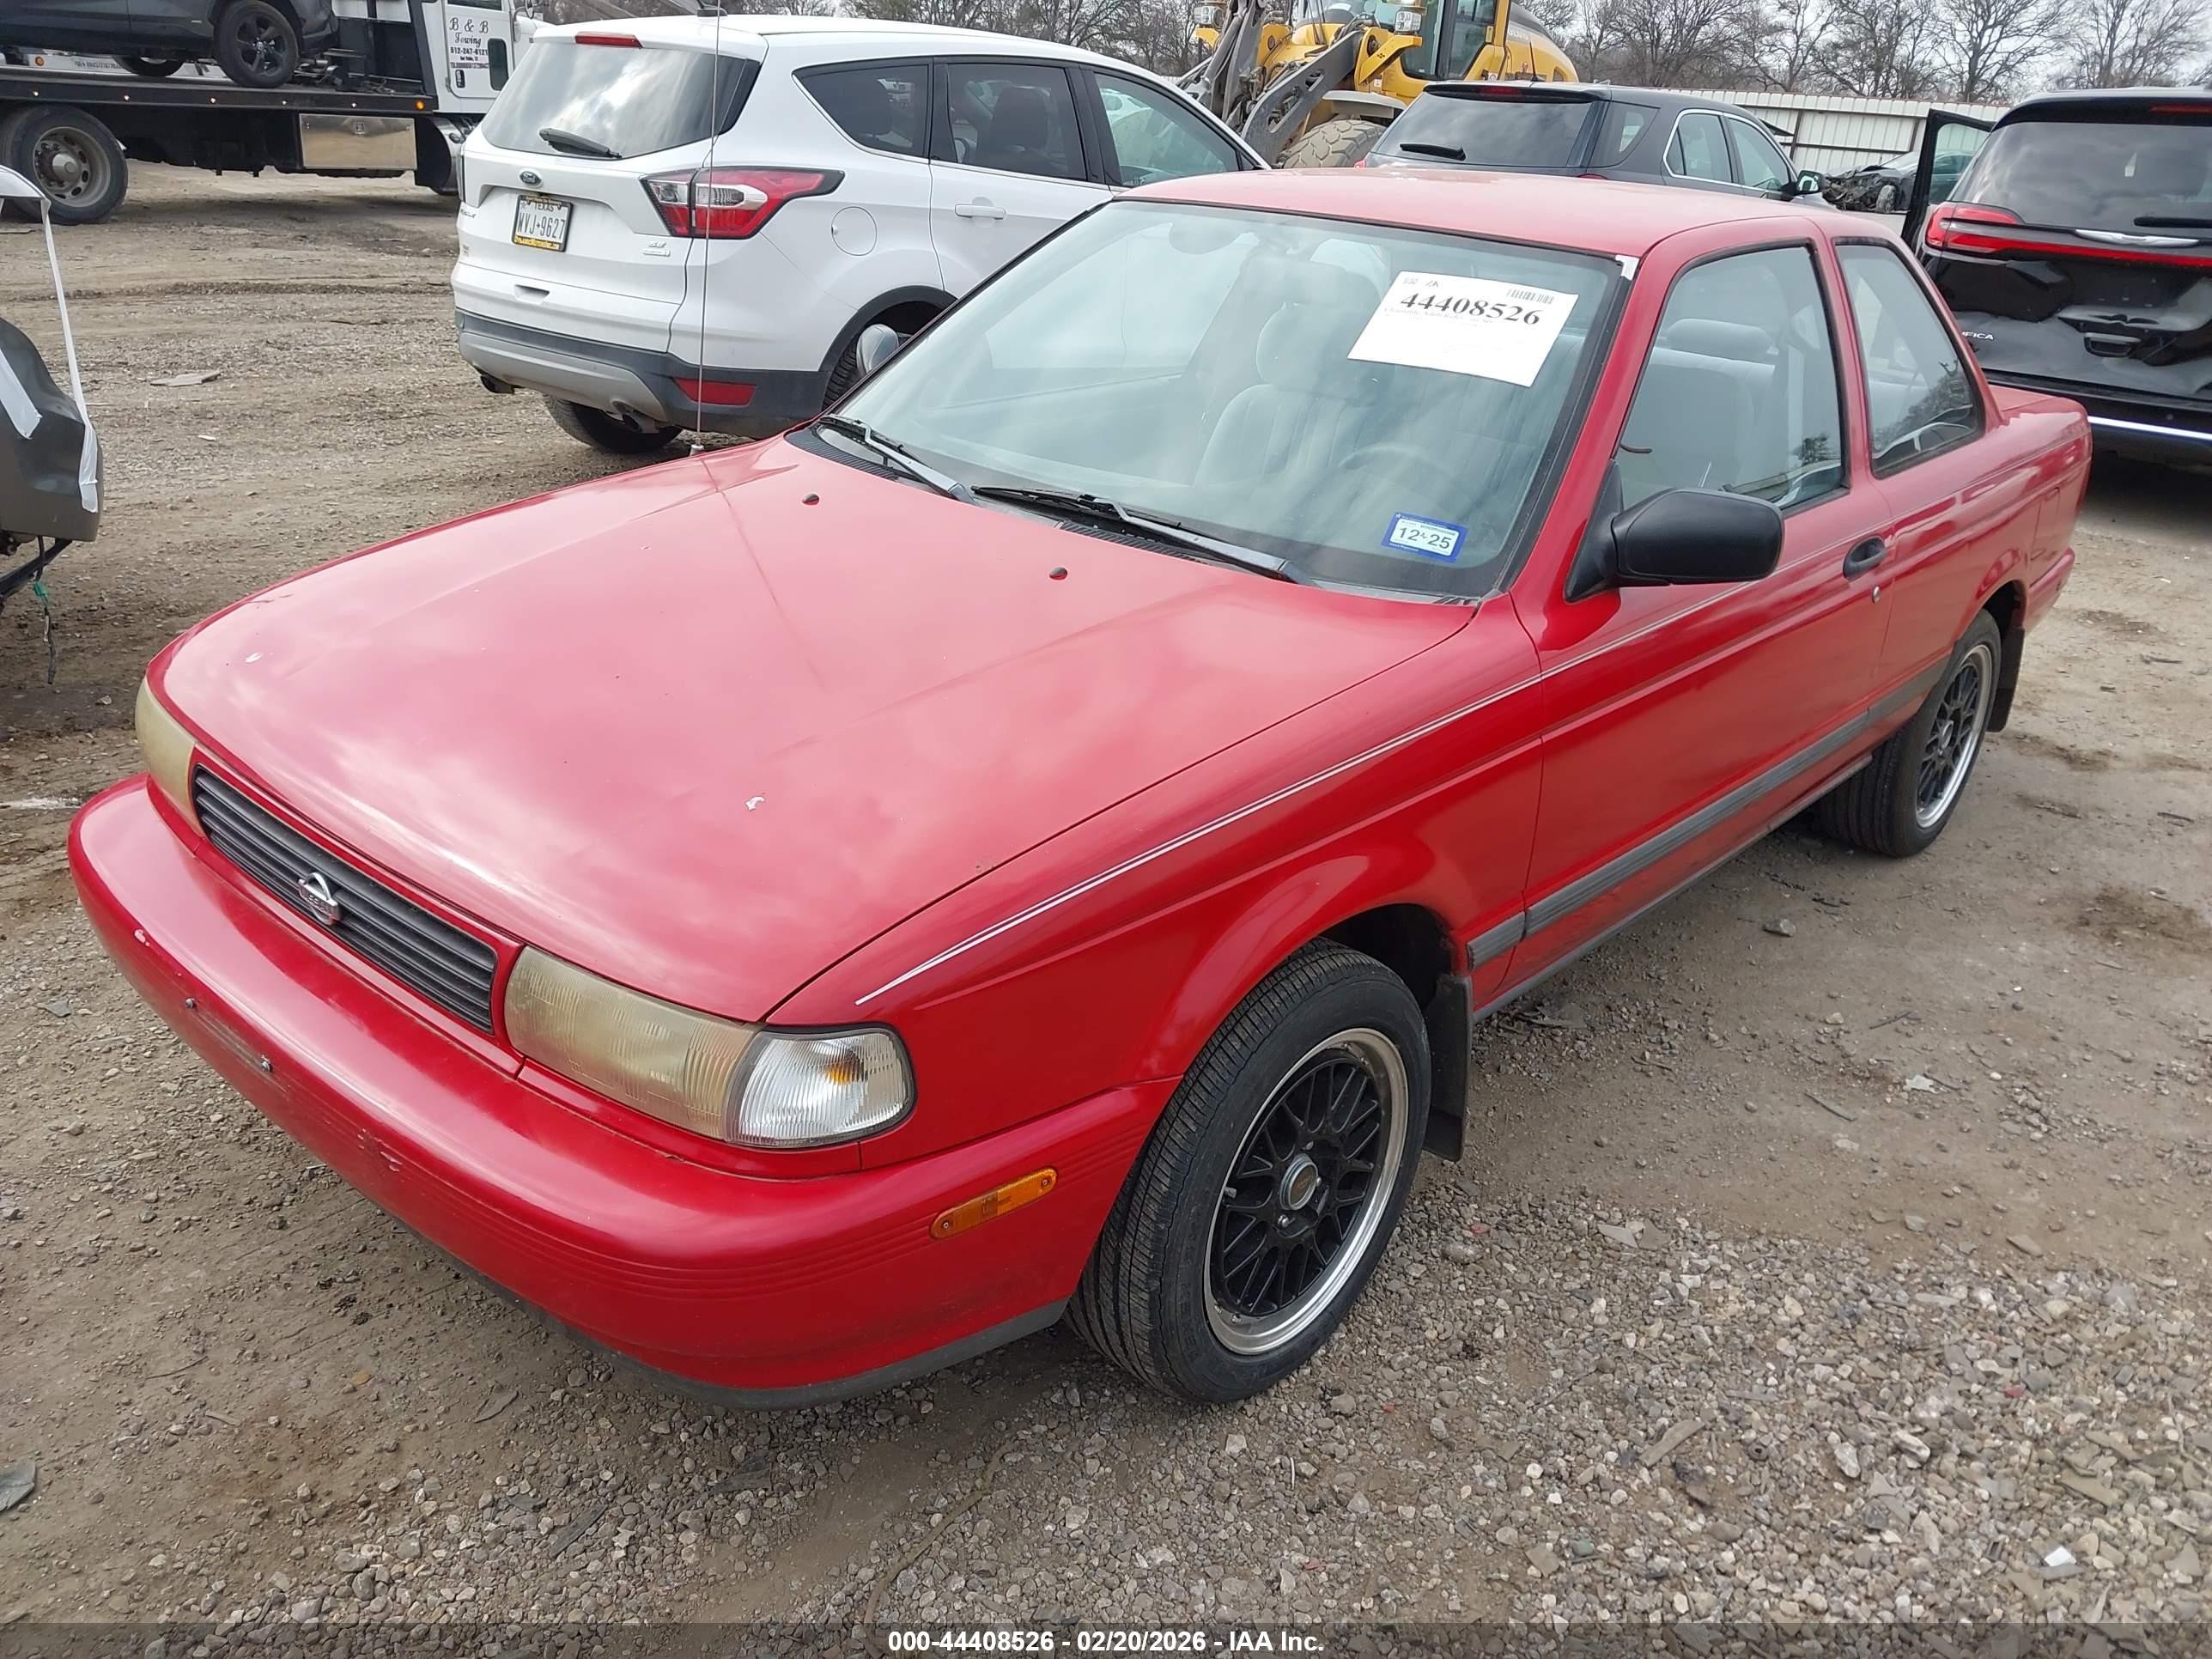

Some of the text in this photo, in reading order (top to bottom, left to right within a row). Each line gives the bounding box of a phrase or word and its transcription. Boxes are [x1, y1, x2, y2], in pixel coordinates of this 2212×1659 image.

[449, 17, 489, 33] B & B
[455, 32, 481, 48] Towing
[534, 203, 554, 213] TEXAS
[1401, 293, 1544, 325] 44408526
